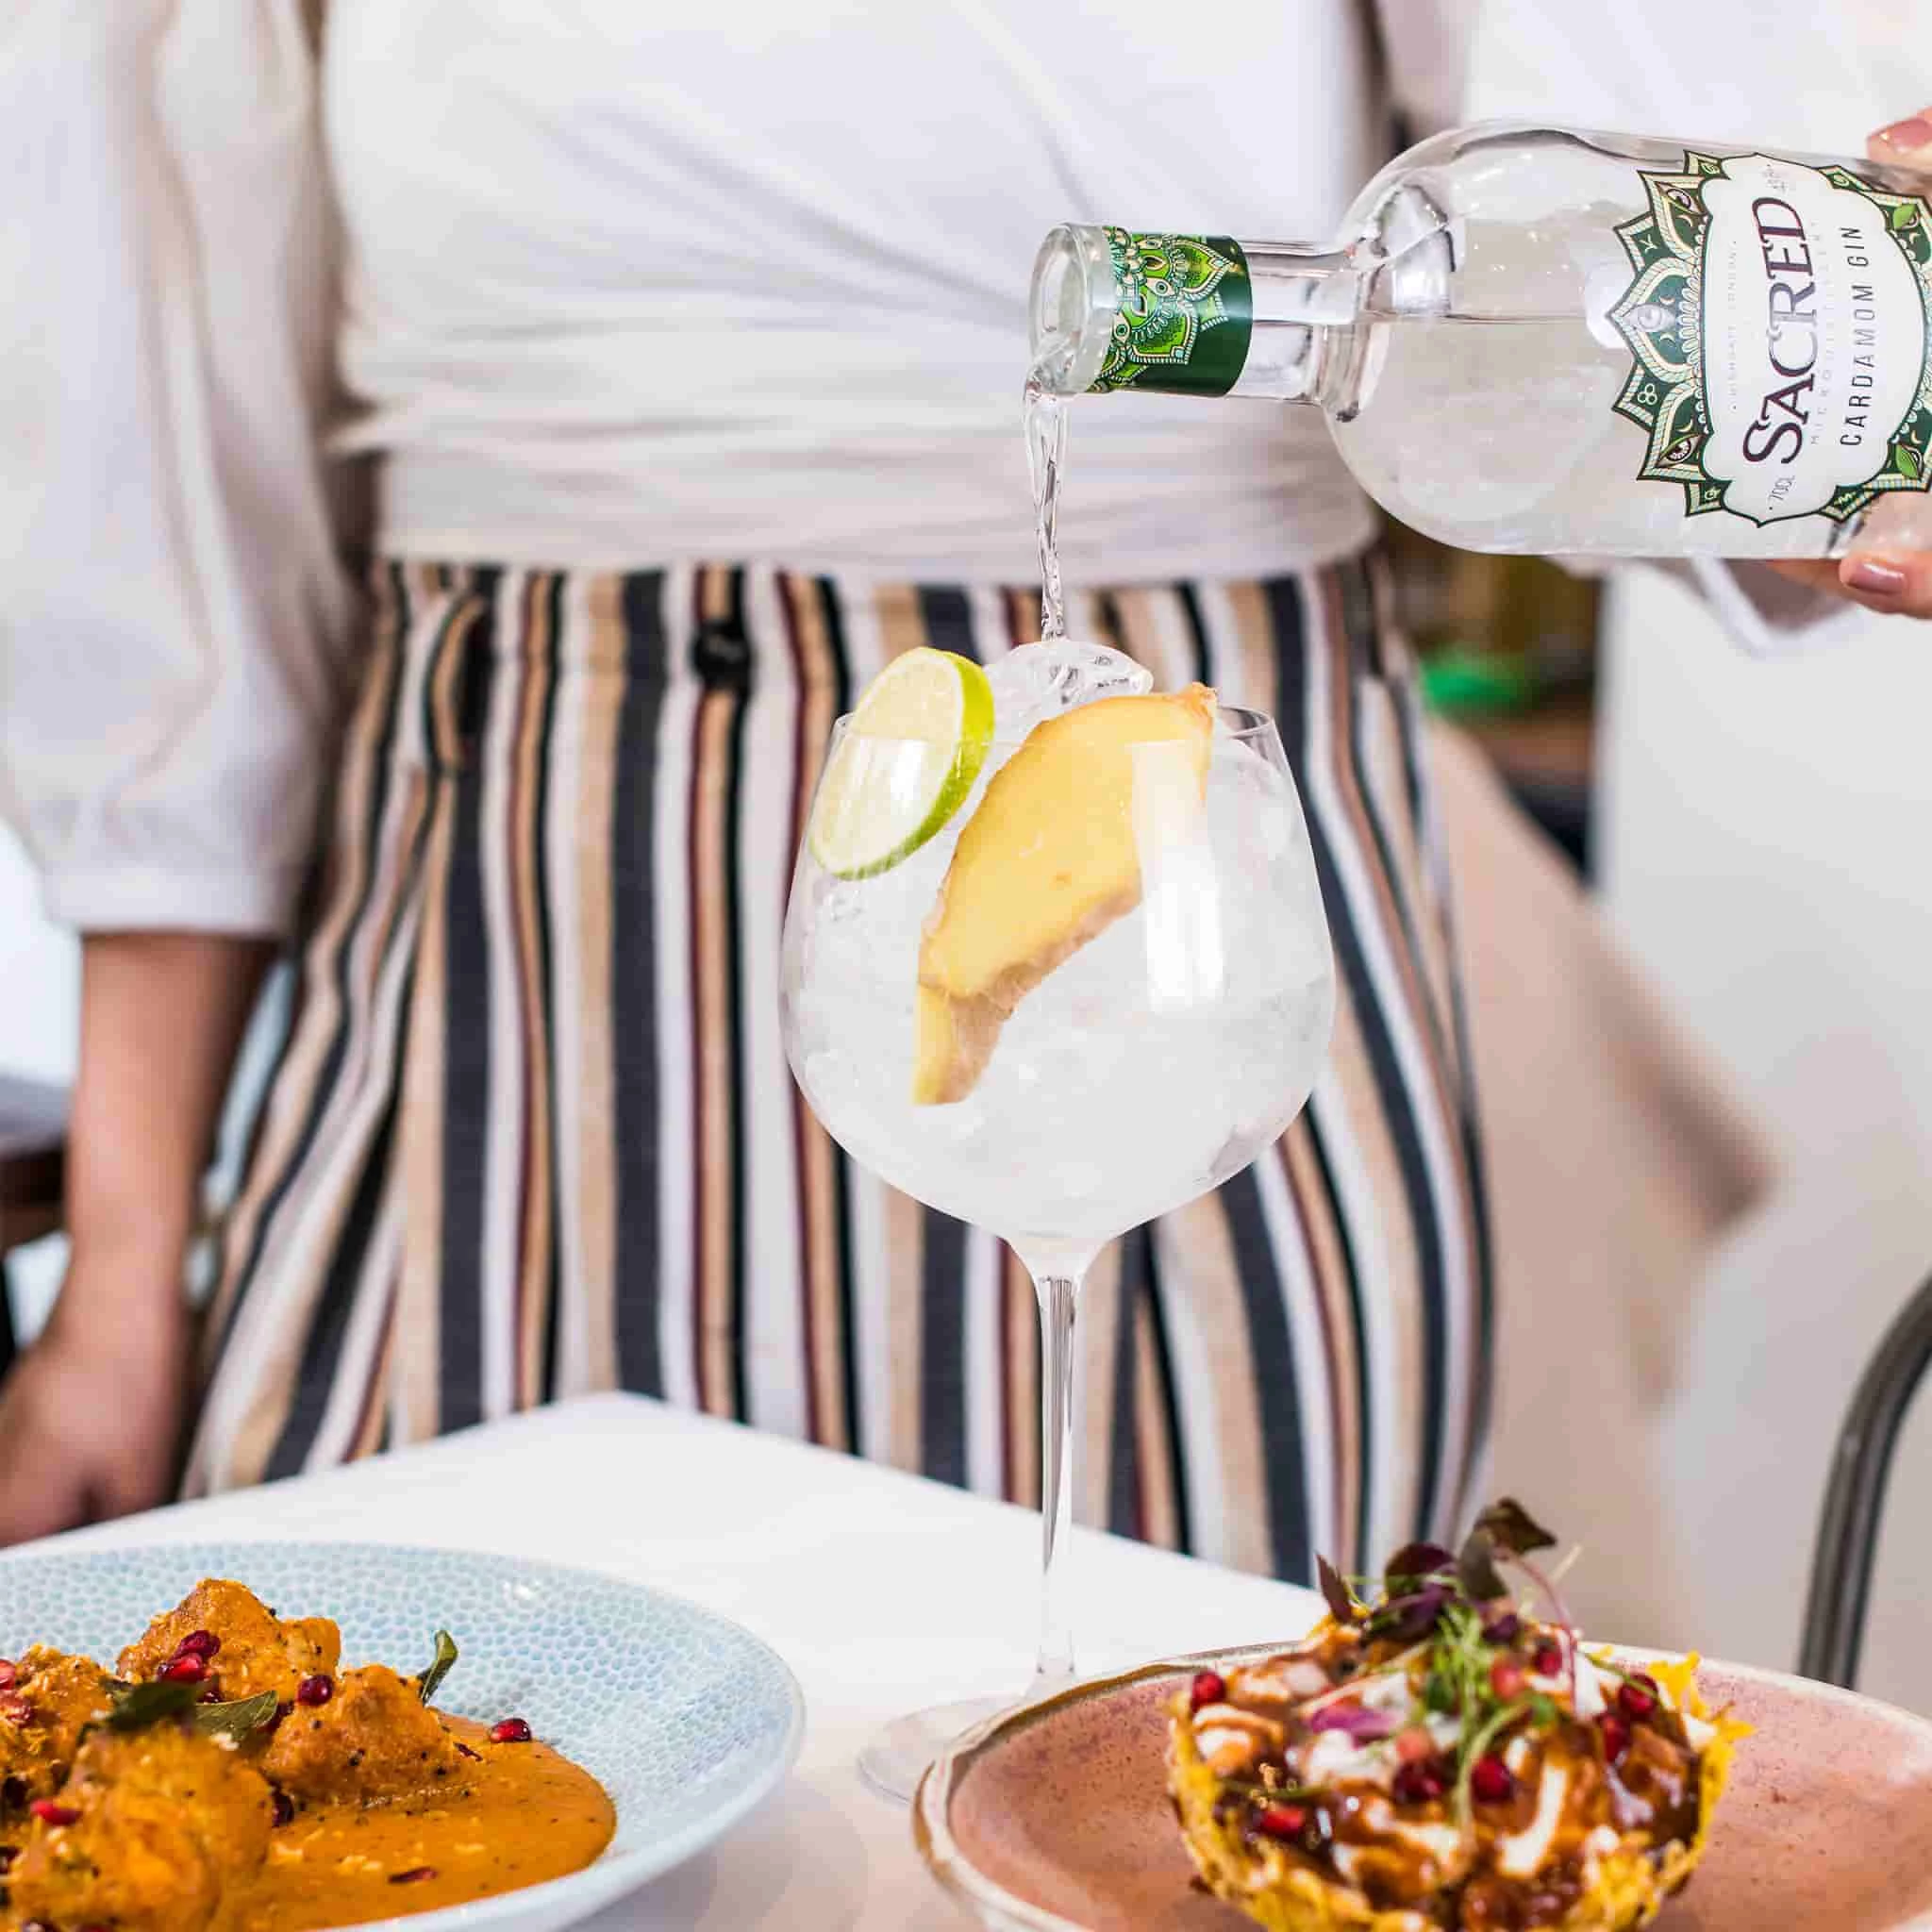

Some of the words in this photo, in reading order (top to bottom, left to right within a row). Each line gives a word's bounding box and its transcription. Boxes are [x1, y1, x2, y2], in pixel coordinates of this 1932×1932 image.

[1840, 227, 1869, 267] GIN
[1743, 197, 1819, 464] SACRED
[1840, 285, 1875, 445] CARDAMOM
